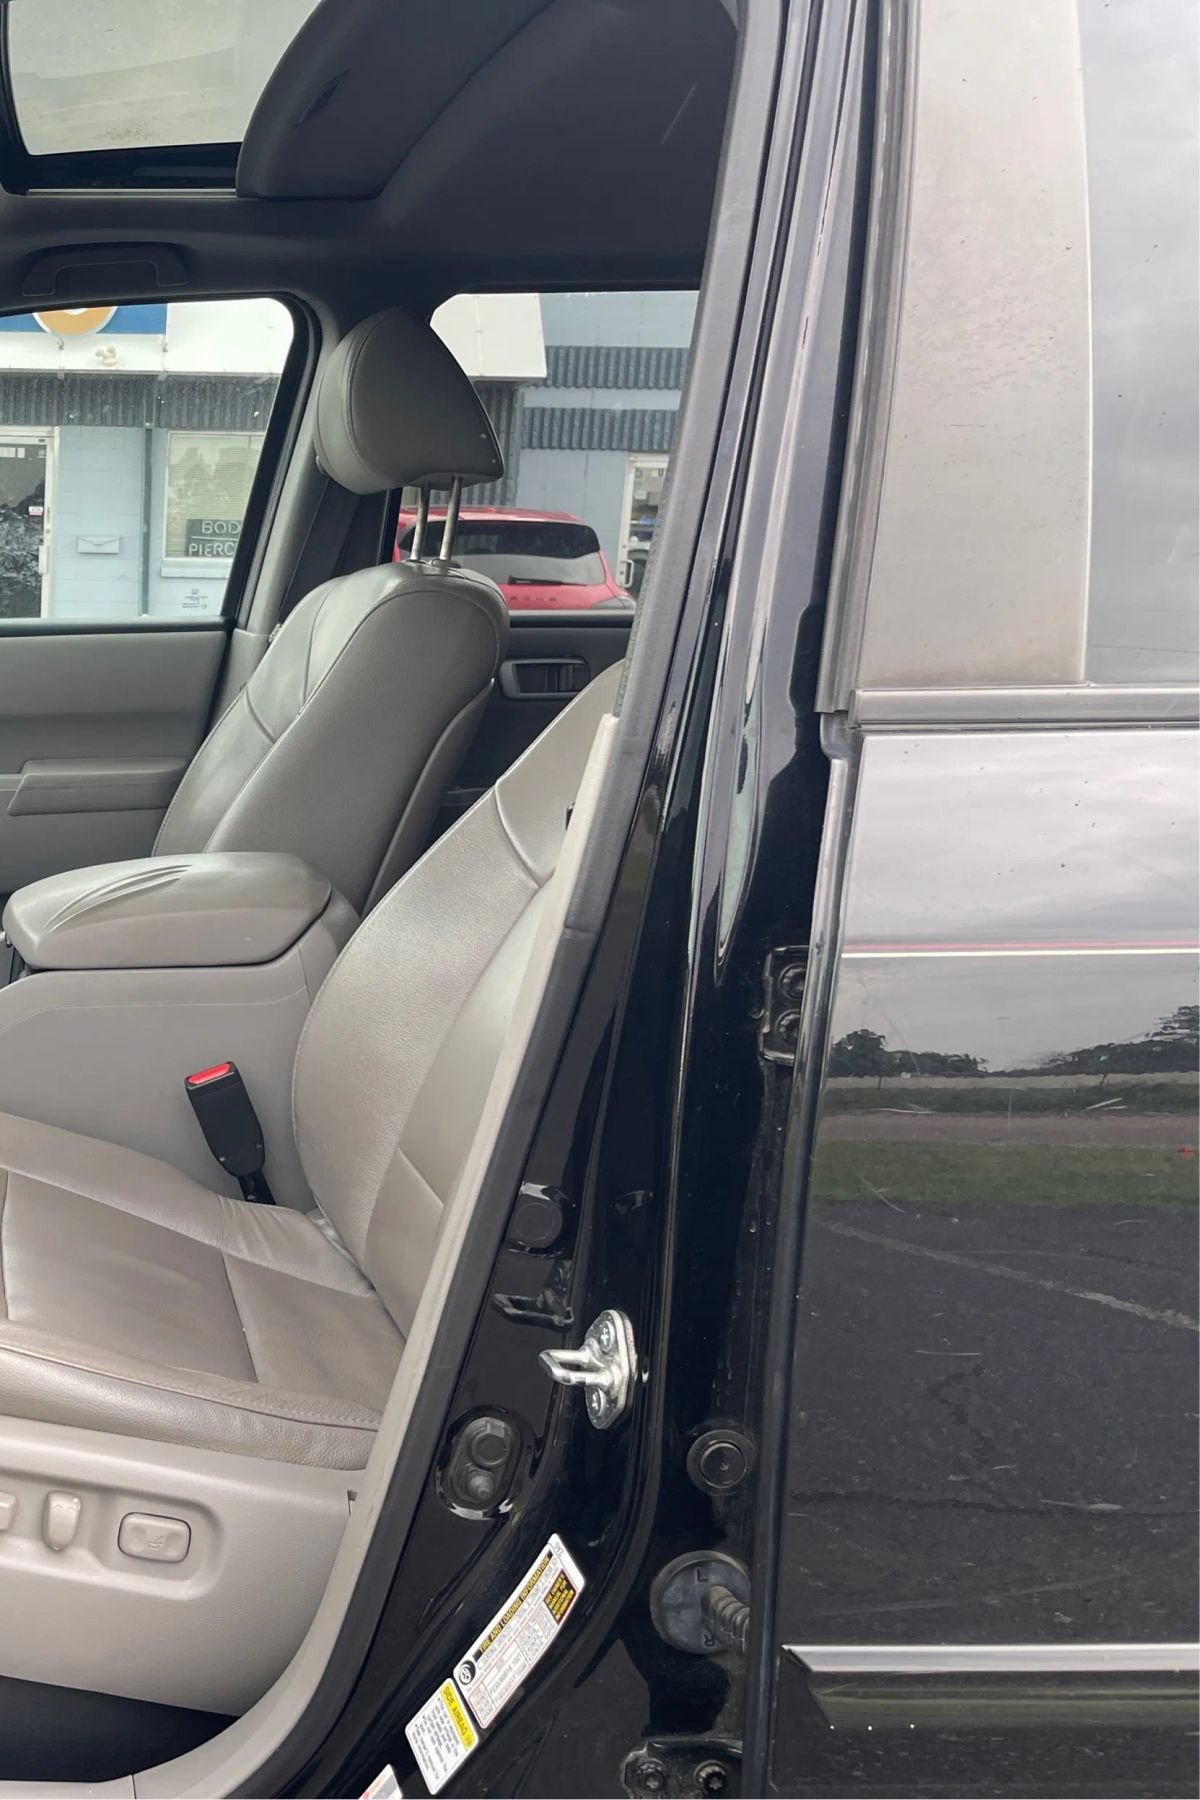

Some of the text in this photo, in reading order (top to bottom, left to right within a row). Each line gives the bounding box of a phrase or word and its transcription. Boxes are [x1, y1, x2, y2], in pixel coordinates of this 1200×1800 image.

[479, 1555, 549, 1652] TIRE AND LOADING INFORMATION
[443, 1686, 455, 1706] SIDE
[451, 1708, 469, 1735] AIRBAG
